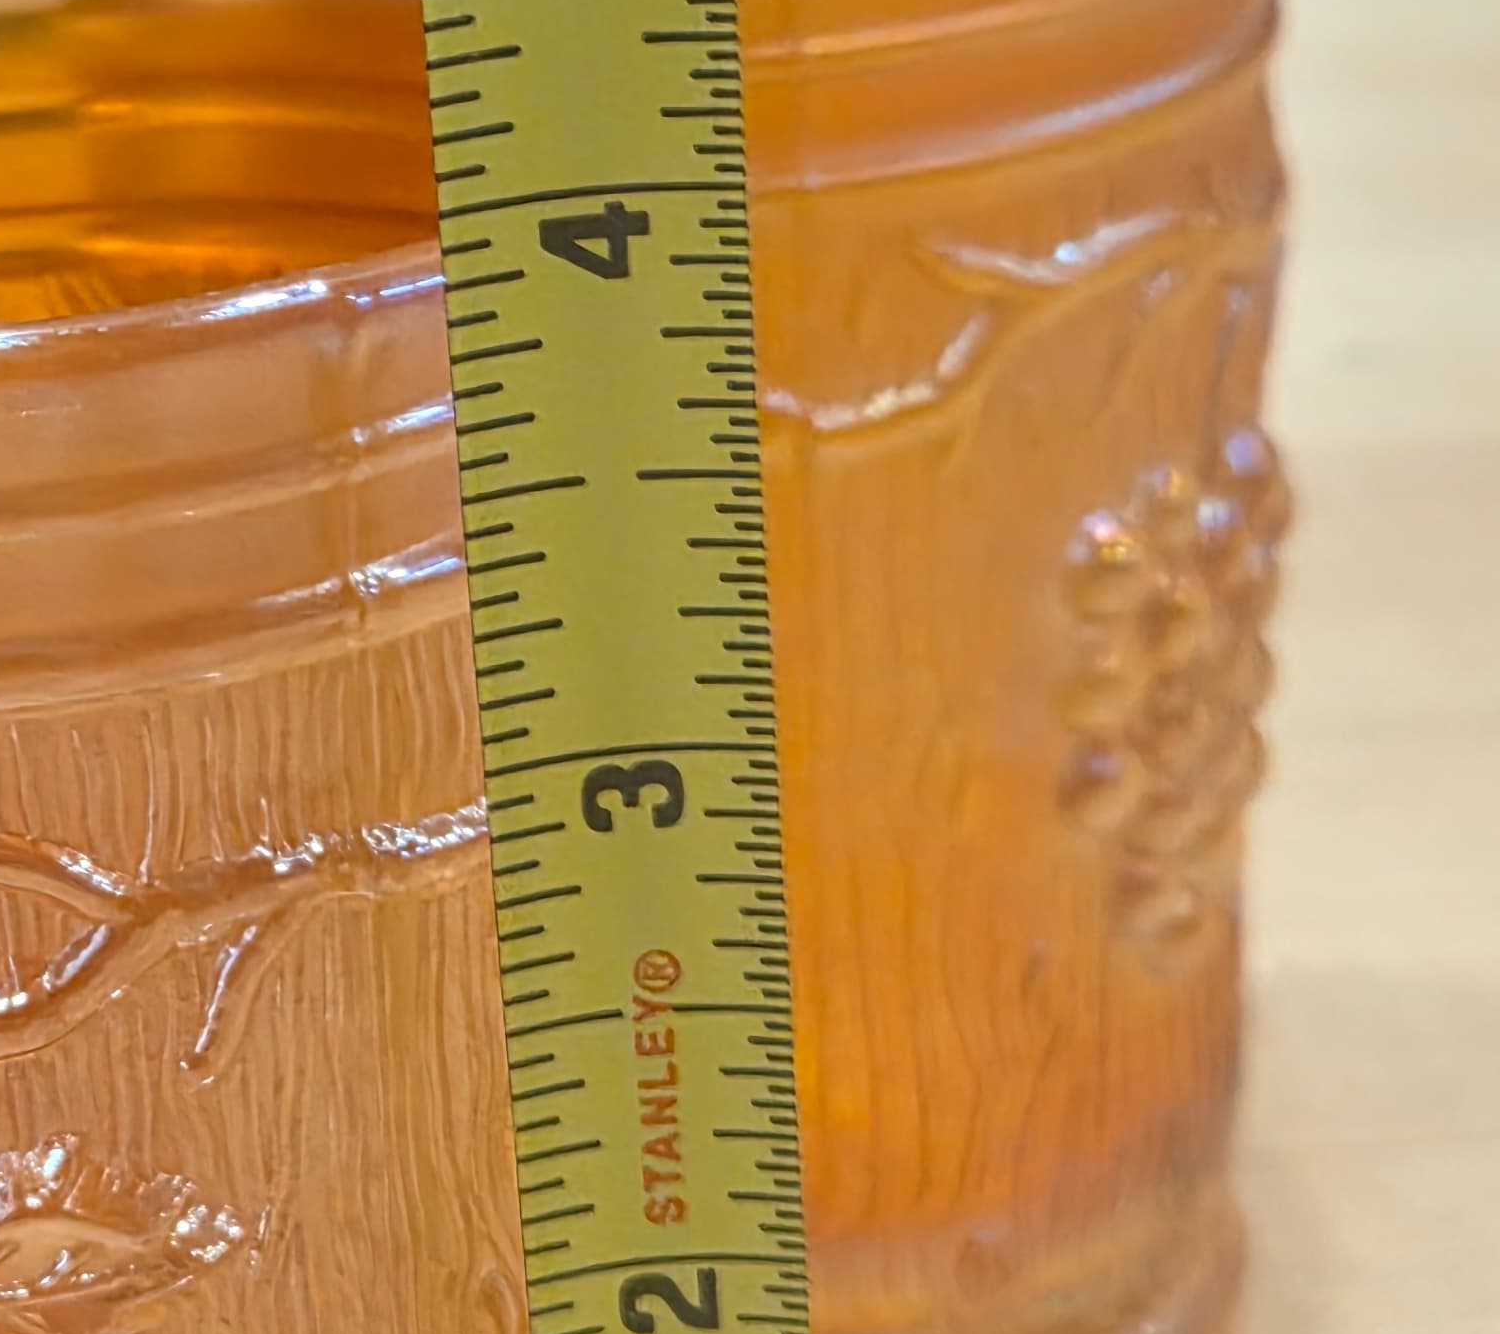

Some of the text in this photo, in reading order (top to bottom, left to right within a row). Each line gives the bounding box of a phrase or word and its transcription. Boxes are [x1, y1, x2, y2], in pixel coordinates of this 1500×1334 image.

[539, 201, 650, 279] 4
[581, 759, 685, 833] 3
[618, 1266, 720, 1334] 2
